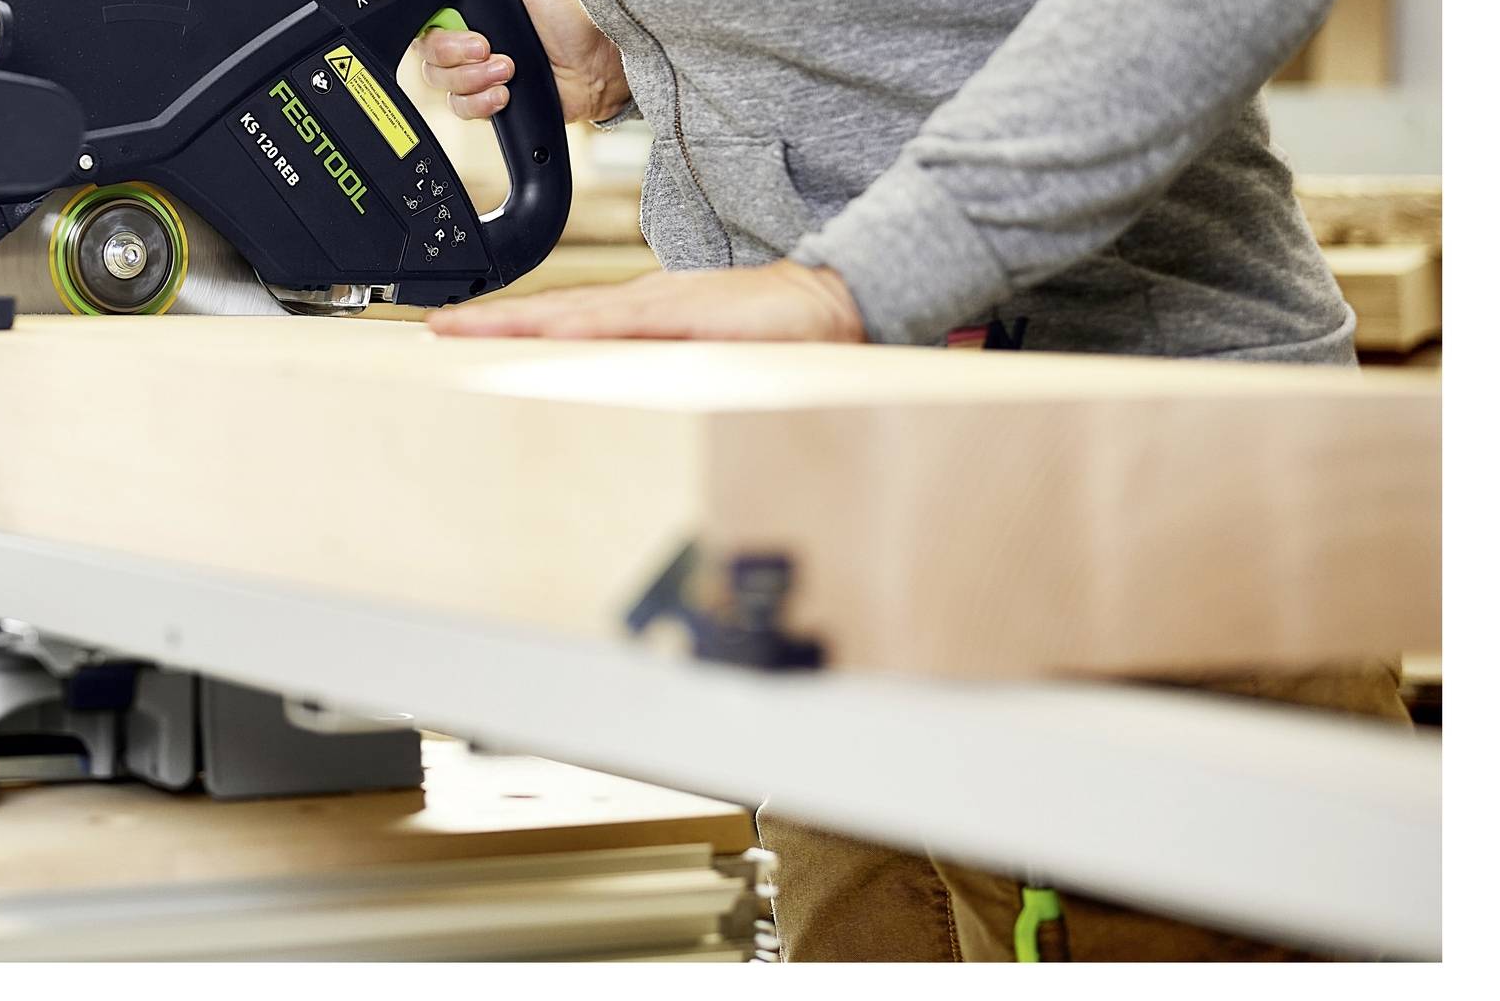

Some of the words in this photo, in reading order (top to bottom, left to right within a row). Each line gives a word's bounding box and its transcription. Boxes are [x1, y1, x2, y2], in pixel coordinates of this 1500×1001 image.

[239, 112, 260, 135] KS
[256, 132, 279, 159] 120
[274, 155, 300, 187] REB
[268, 79, 368, 215] FESTOOL
[416, 179, 425, 191] L
[434, 228, 446, 242] R
